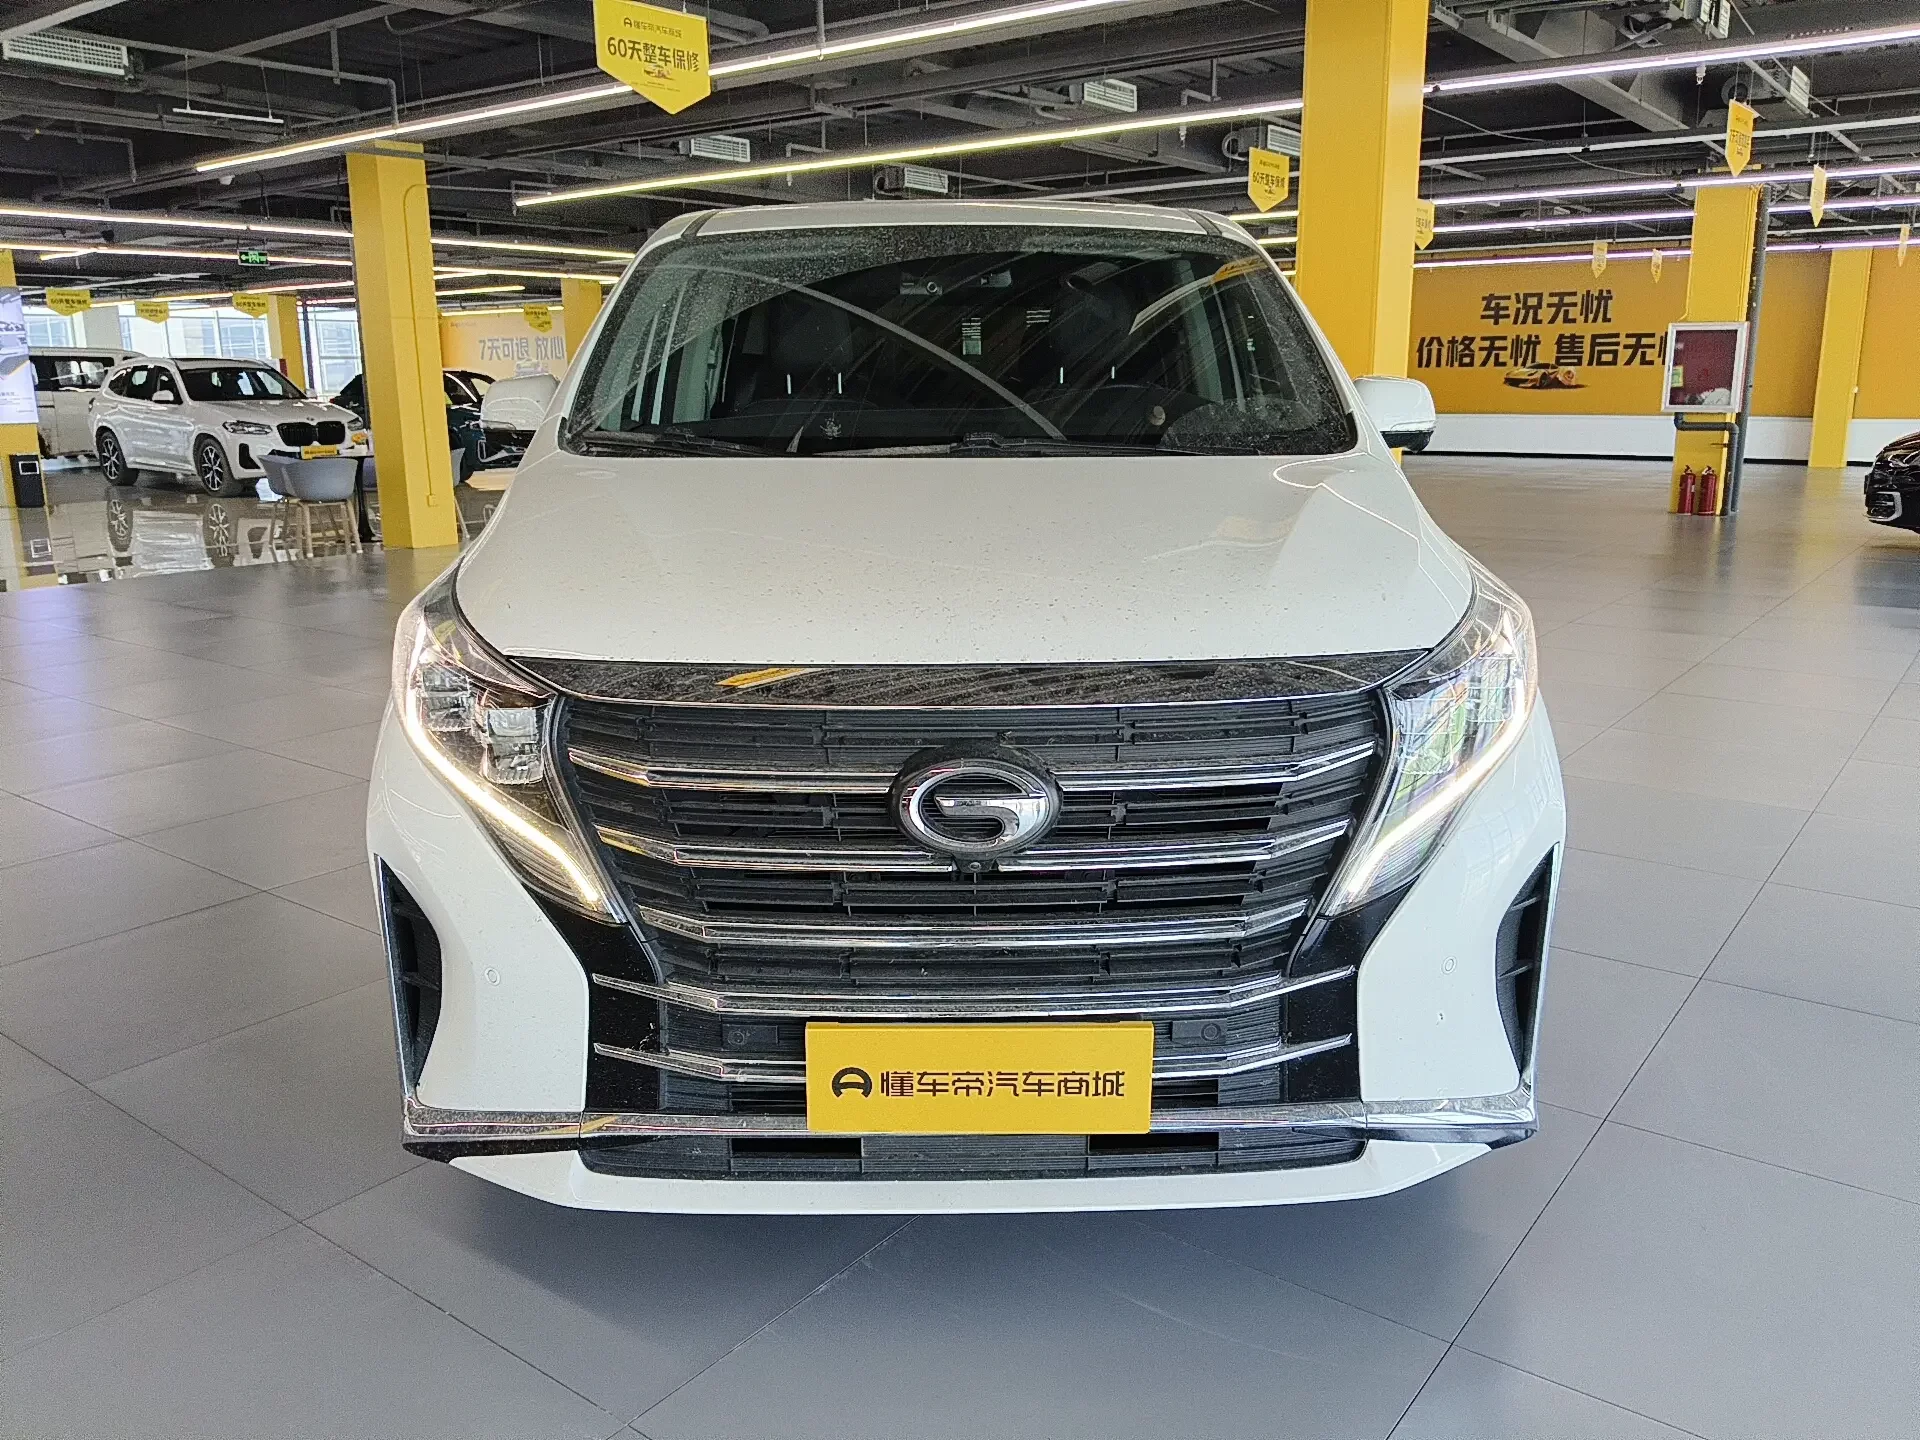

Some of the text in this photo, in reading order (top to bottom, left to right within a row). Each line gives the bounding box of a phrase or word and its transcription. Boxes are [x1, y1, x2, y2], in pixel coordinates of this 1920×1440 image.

[607, 36, 700, 73] 60天整车保修
[1480, 289, 1613, 326] 车况无忧
[478, 336, 566, 361] 7天可退 放心
[1416, 333, 1541, 369] 价格无忧
[880, 1070, 1126, 1097] 懂车帝汽车商城
